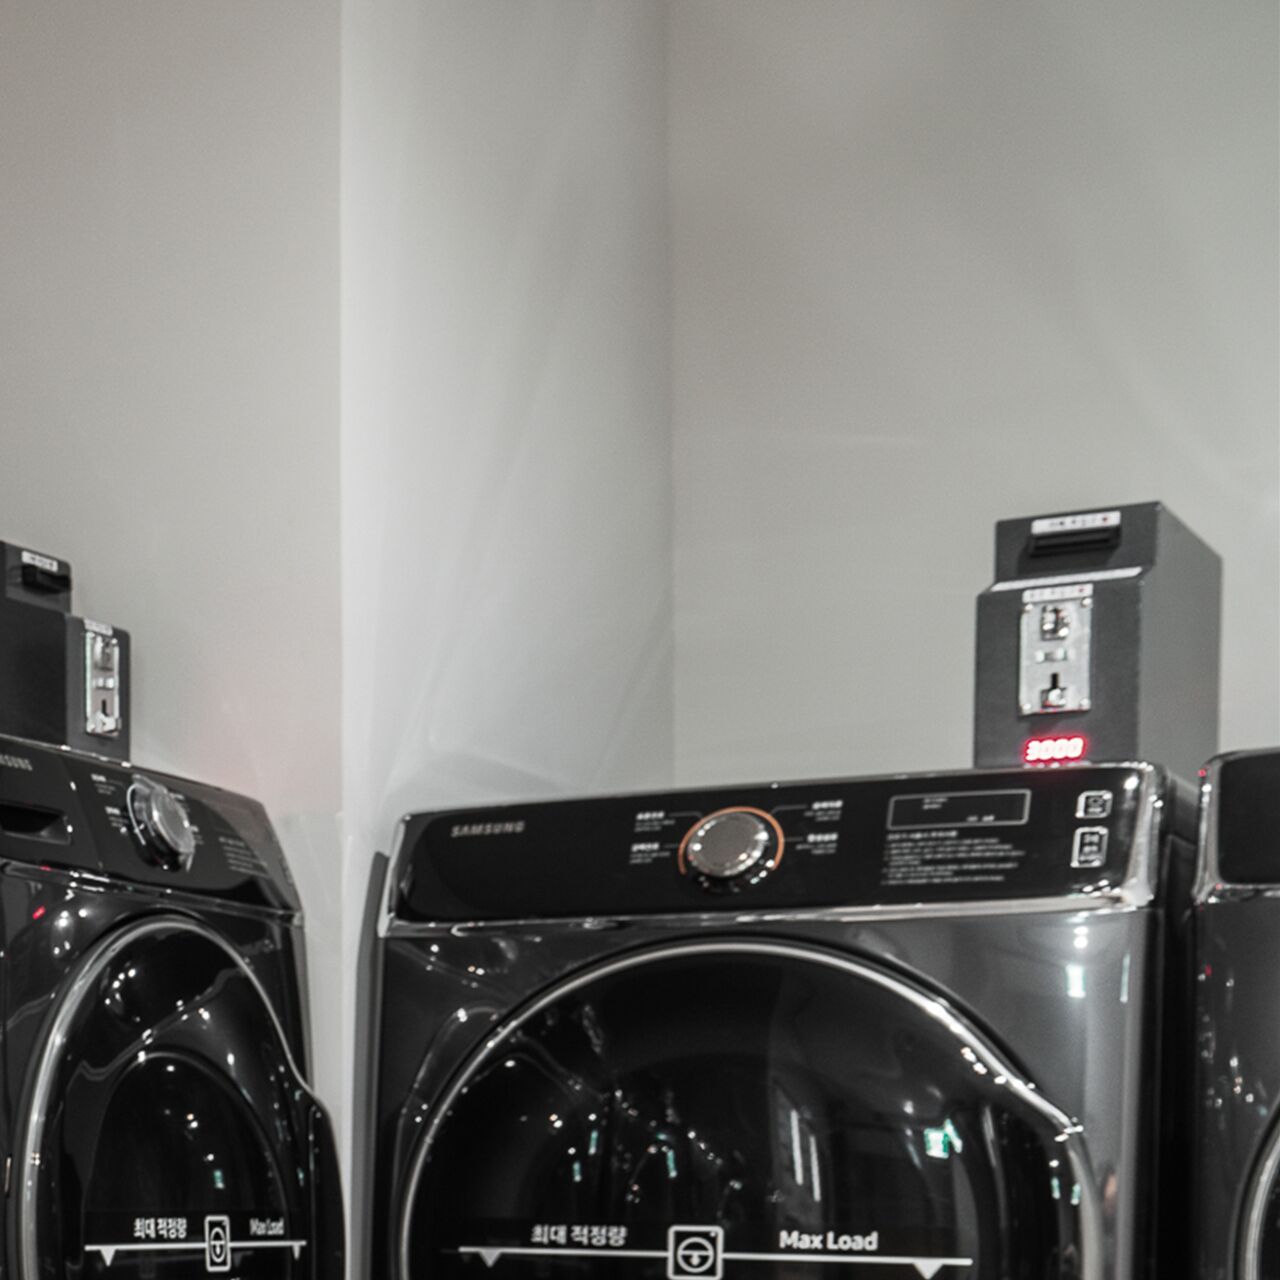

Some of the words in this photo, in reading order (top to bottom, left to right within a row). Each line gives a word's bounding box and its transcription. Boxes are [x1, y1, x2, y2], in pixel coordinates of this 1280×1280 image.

[450, 820, 525, 838] SAMSUNG
[530, 1225, 567, 1245] 최대
[569, 1225, 628, 1248] 적정량
[779, 1231, 823, 1250] Max
[826, 1231, 879, 1252] Load
